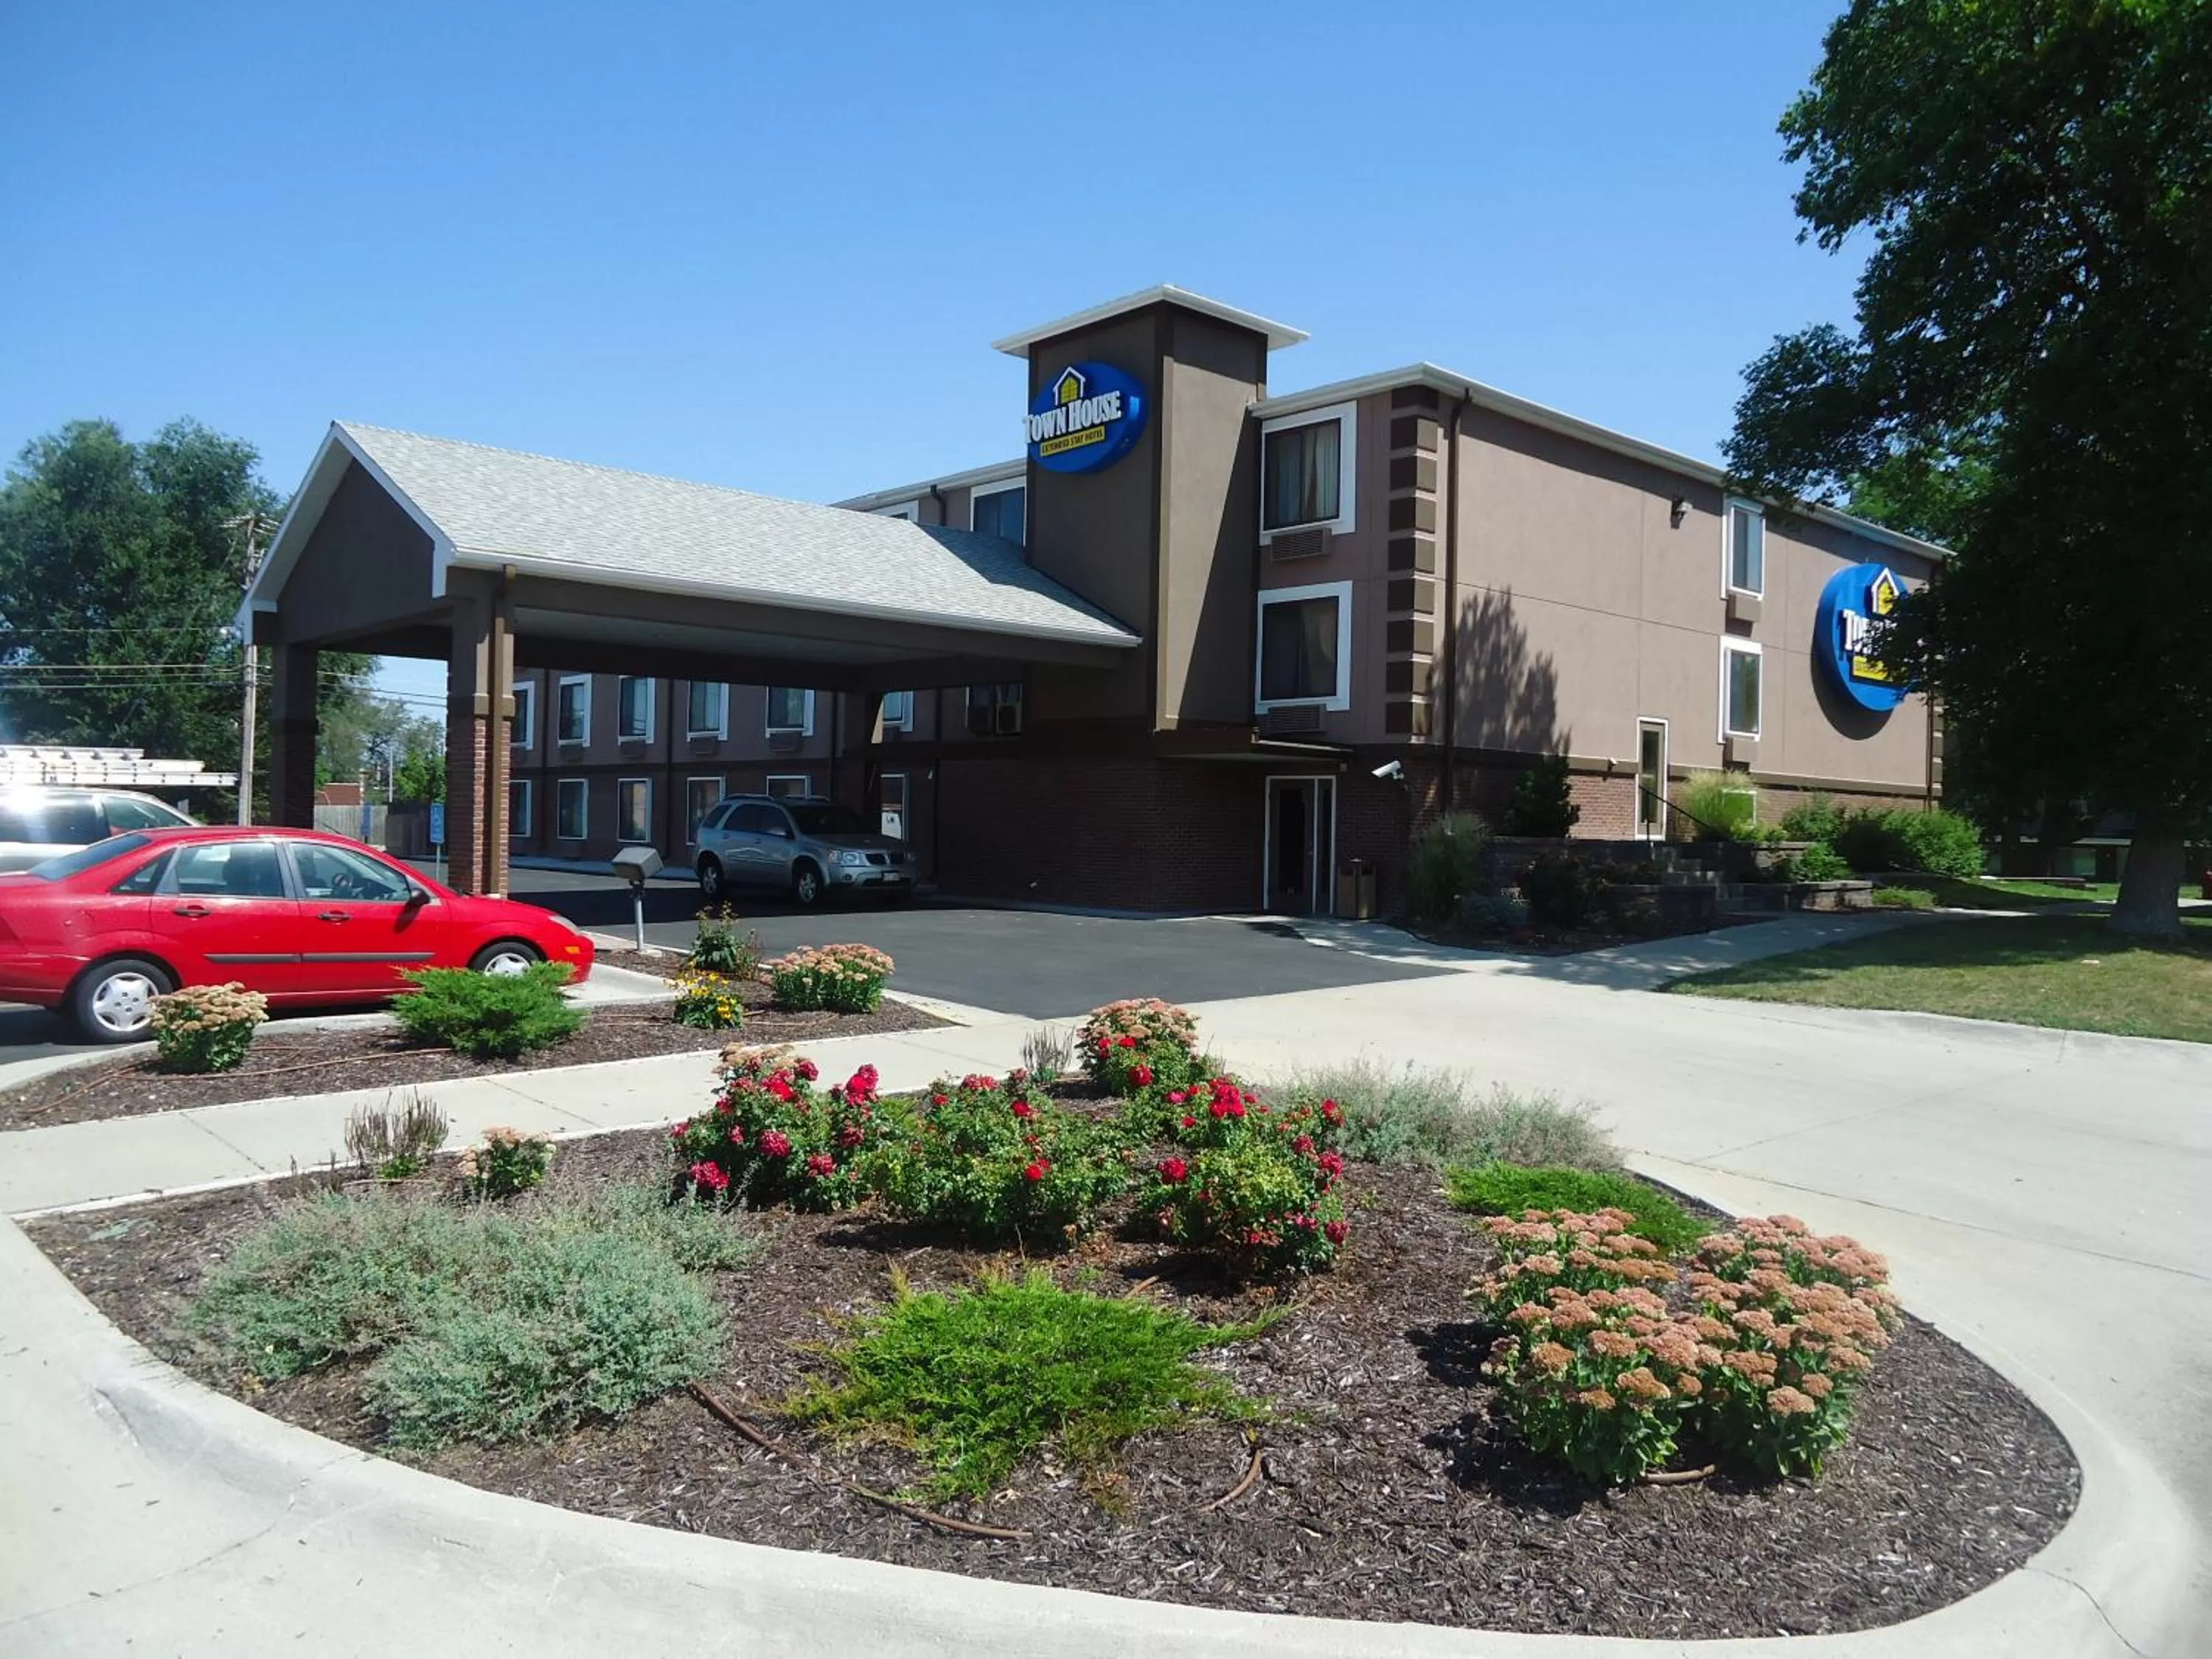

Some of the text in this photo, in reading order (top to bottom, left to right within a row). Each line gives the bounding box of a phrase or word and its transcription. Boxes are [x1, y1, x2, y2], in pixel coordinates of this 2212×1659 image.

[1025, 390, 1121, 442] TOWN HOUSE
[1070, 435, 1084, 447] STAY
